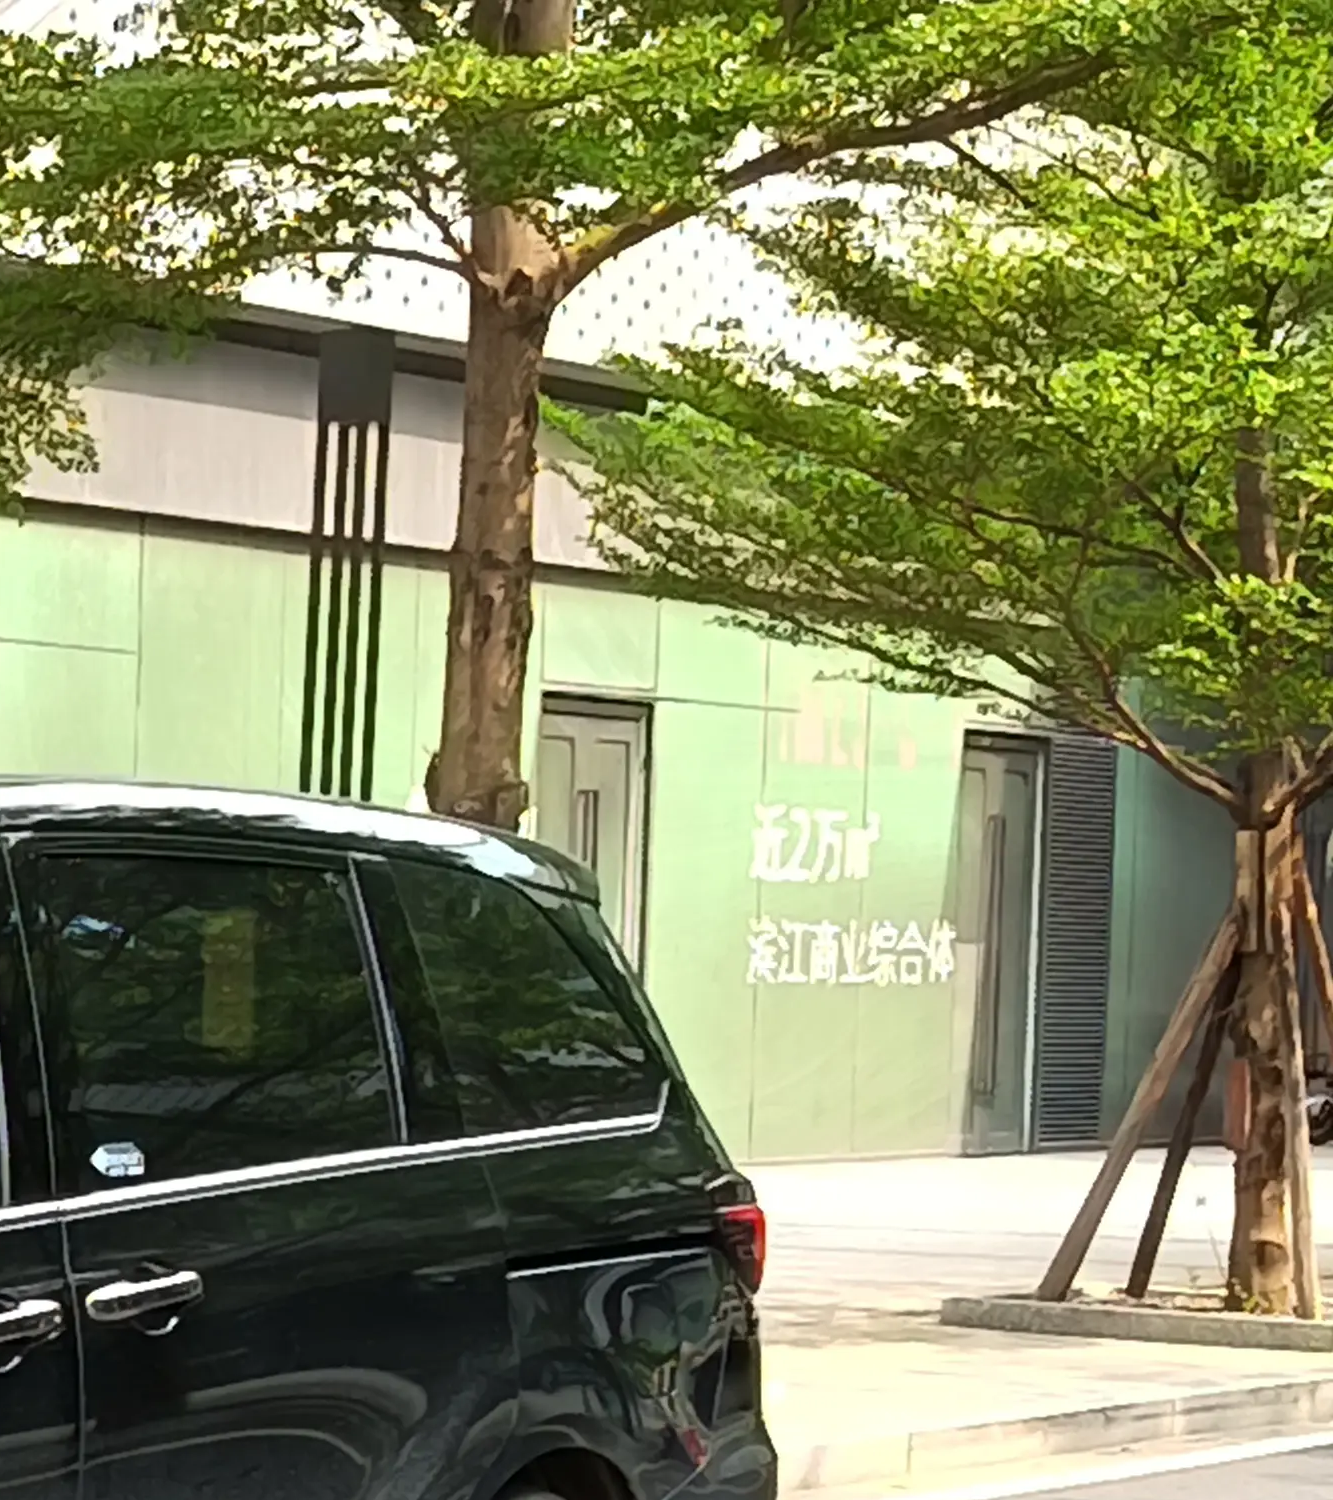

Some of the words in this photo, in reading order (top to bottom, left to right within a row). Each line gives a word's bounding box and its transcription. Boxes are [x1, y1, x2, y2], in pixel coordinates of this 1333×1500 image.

[746, 915, 956, 987] 滨江商业综合体
